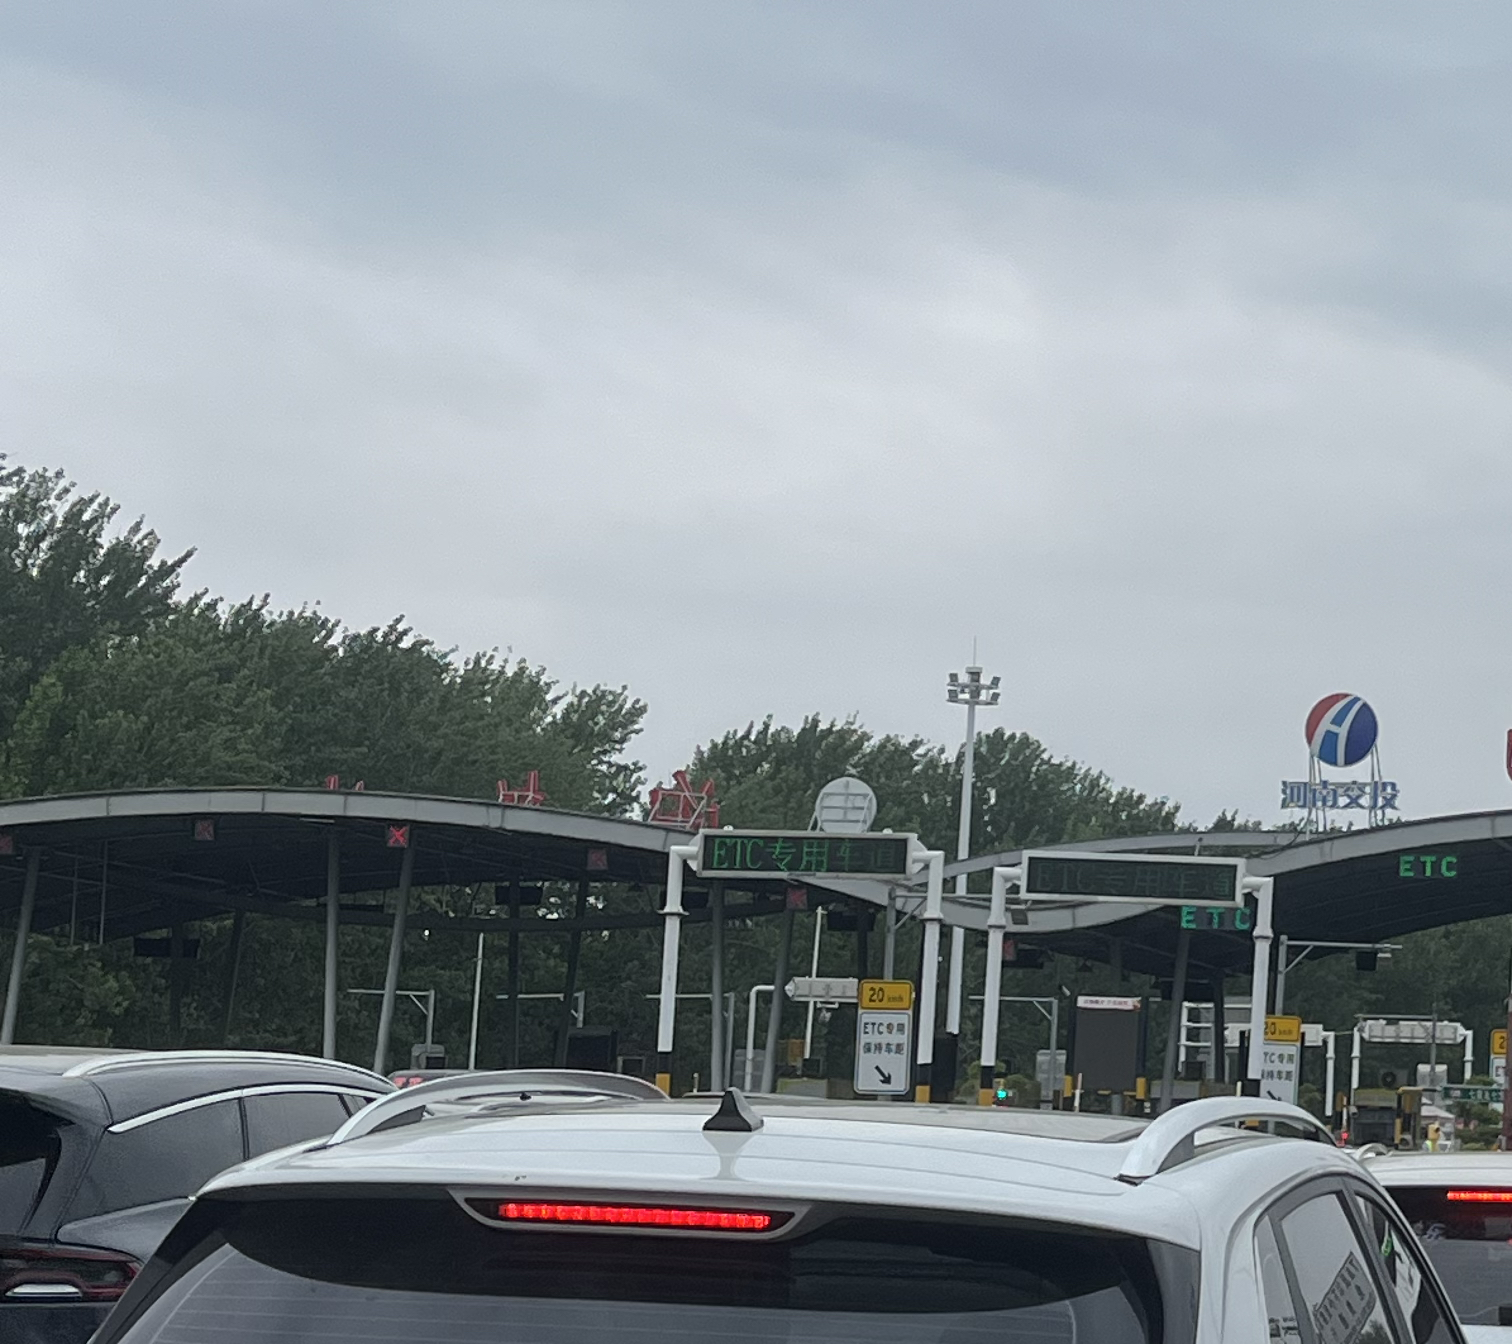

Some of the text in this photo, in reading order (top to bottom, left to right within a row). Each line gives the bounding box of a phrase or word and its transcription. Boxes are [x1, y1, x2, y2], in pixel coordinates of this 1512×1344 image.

[1280, 779, 1400, 810] 河南交投
[1399, 855, 1458, 877] ETC
[1181, 907, 1250, 929] ETC
[868, 987, 885, 1003] 20
